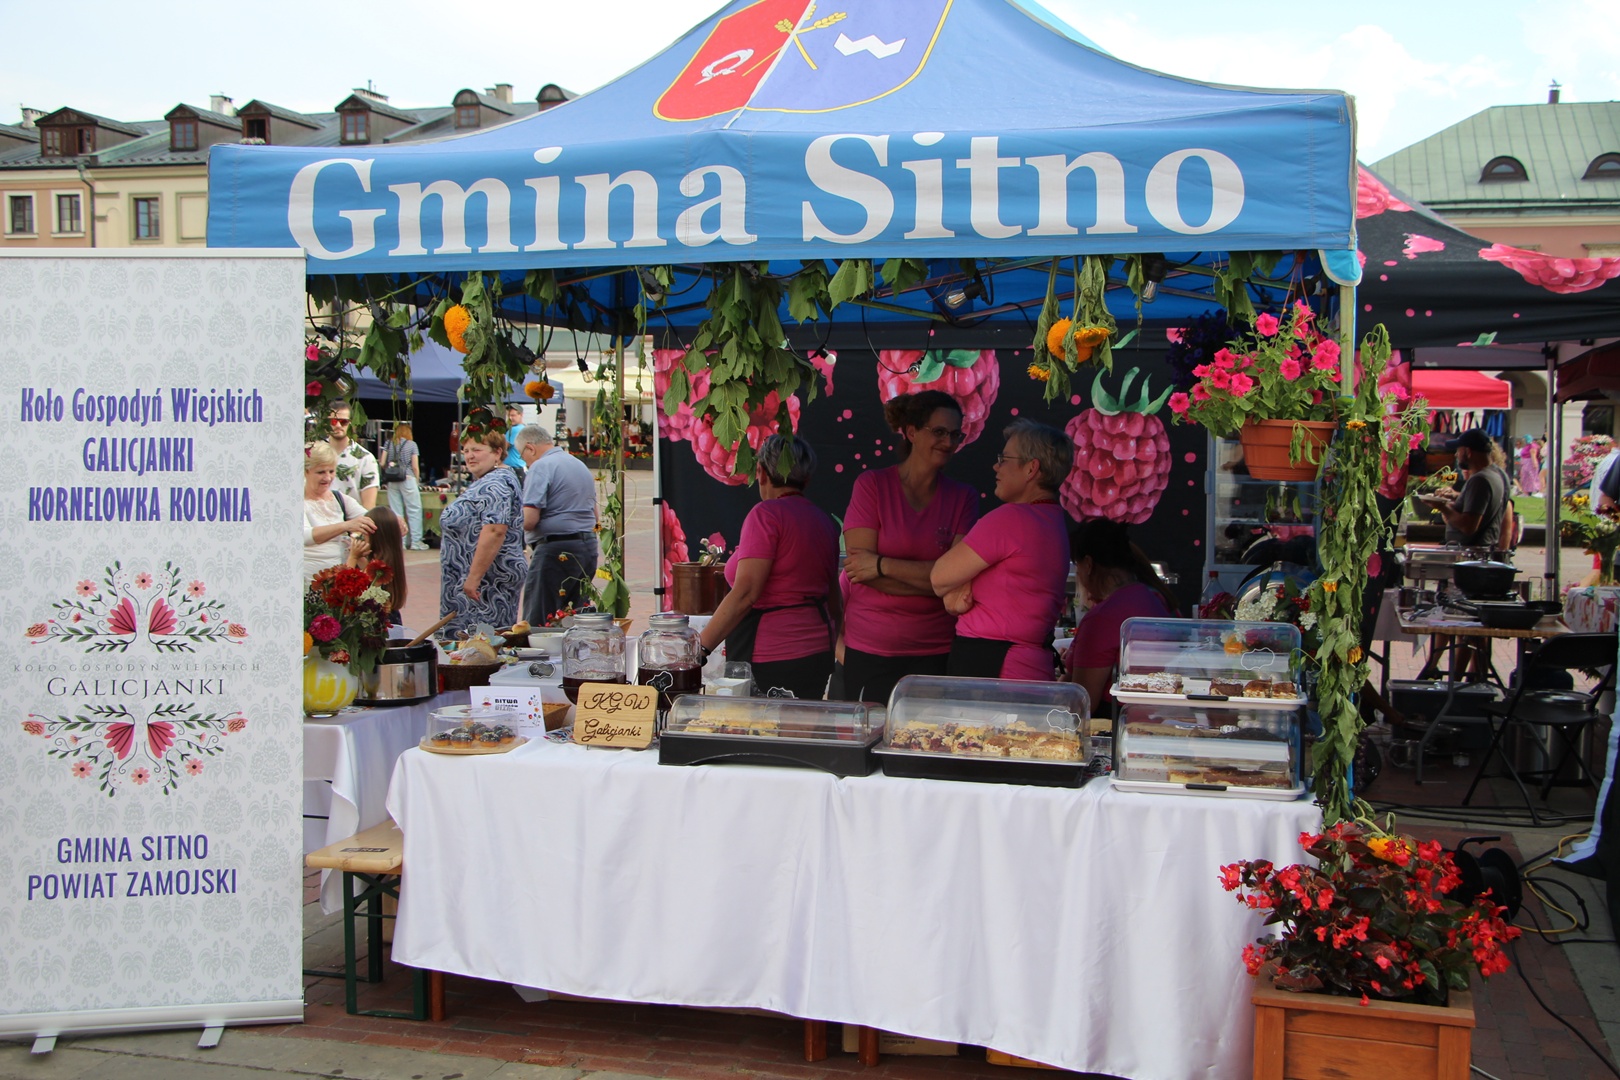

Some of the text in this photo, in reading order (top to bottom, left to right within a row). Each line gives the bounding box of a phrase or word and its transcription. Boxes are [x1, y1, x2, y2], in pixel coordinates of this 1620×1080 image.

[288, 131, 1245, 261] Gmina Sitno
[21, 388, 263, 427] Koło Gospodyń Wiejskich
[83, 437, 194, 476] GALICJANKI
[28, 487, 251, 522] KORNELOWKA KOLONIA
[14, 663, 57, 672] KOŁO
[171, 663, 261, 672] WIEJSKICH
[47, 677, 225, 699] GALICJANKI
[581, 718, 642, 742] Galicjanki
[57, 834, 209, 864] GMINA SITNO
[28, 868, 237, 900] POWIAT ZAMOJSKI
